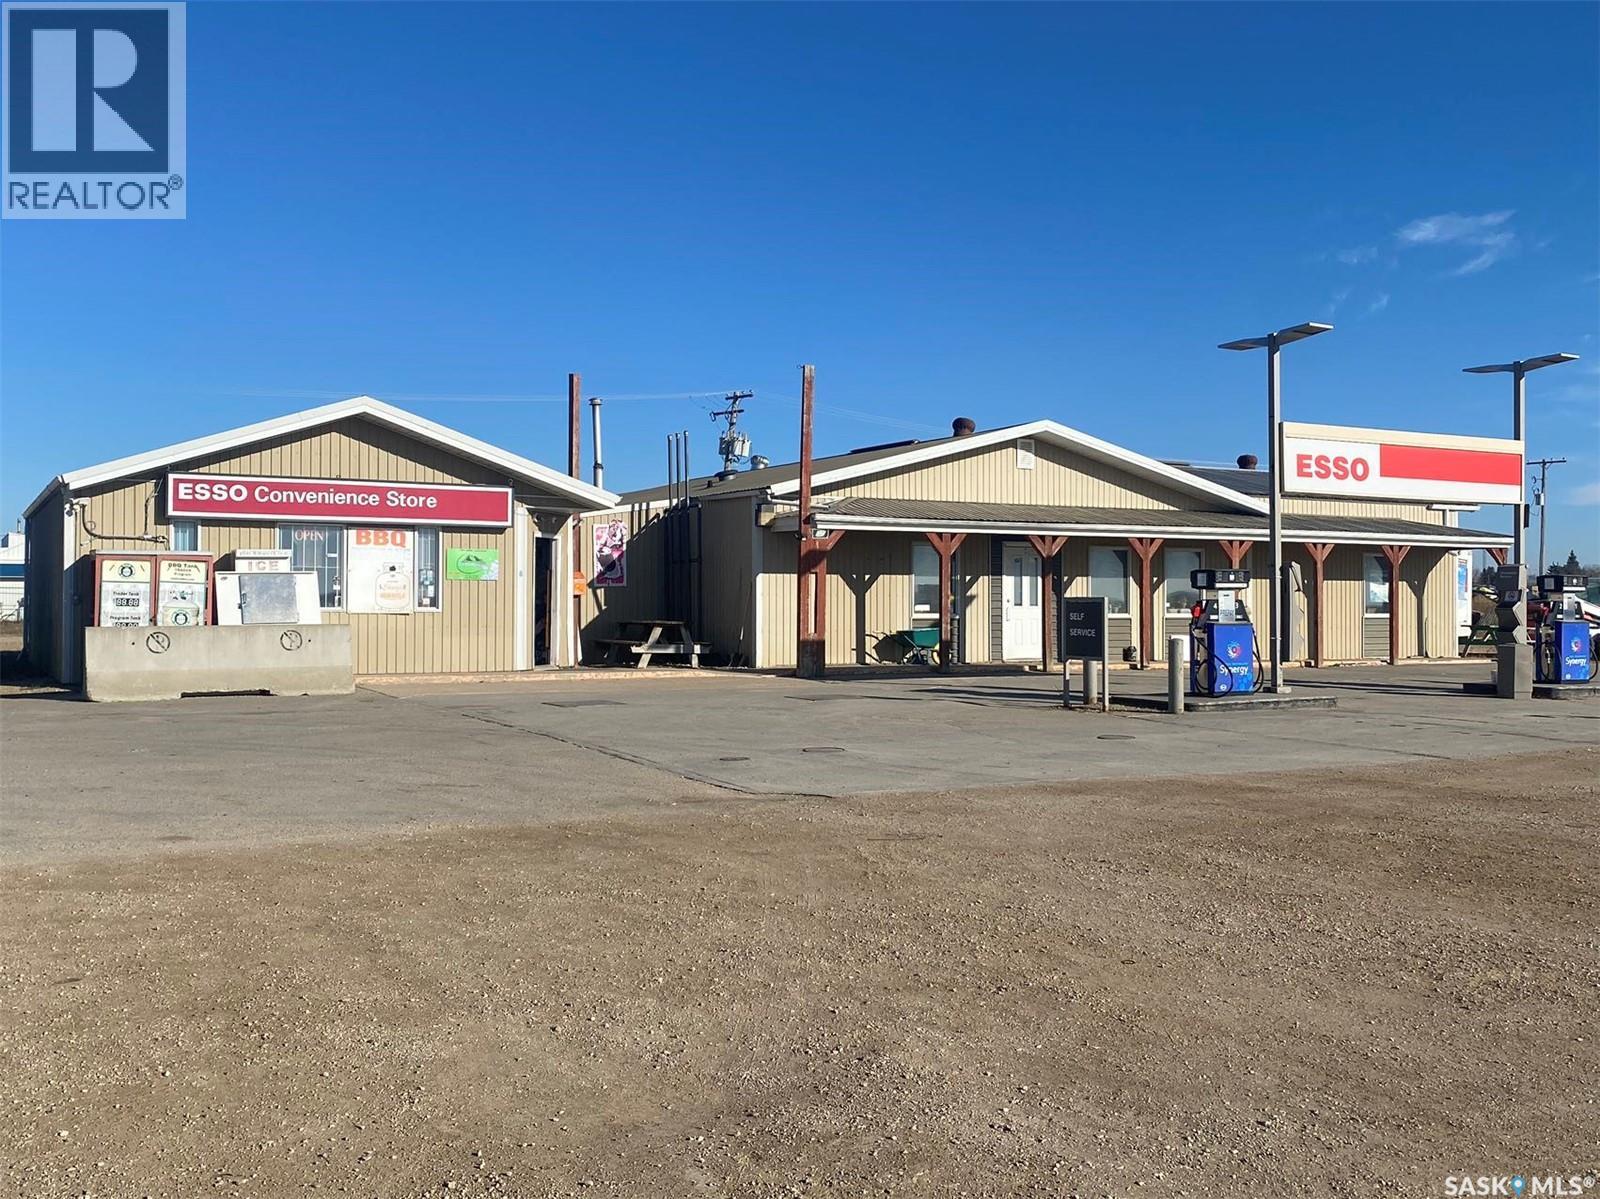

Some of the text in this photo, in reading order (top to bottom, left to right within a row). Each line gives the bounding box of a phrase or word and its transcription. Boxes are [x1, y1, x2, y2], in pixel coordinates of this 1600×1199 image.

[1296, 453, 1370, 482] ESSO
[177, 482, 438, 509] ESSO Convenience Store
[294, 529, 324, 541] OPEN
[356, 527, 406, 548] BBQ
[247, 560, 280, 572] ICE
[1069, 612, 1085, 620] SELF
[1069, 628, 1096, 637] SERVICE
[1565, 656, 1587, 667] Synergy
[1219, 664, 1249, 676] Synergy
